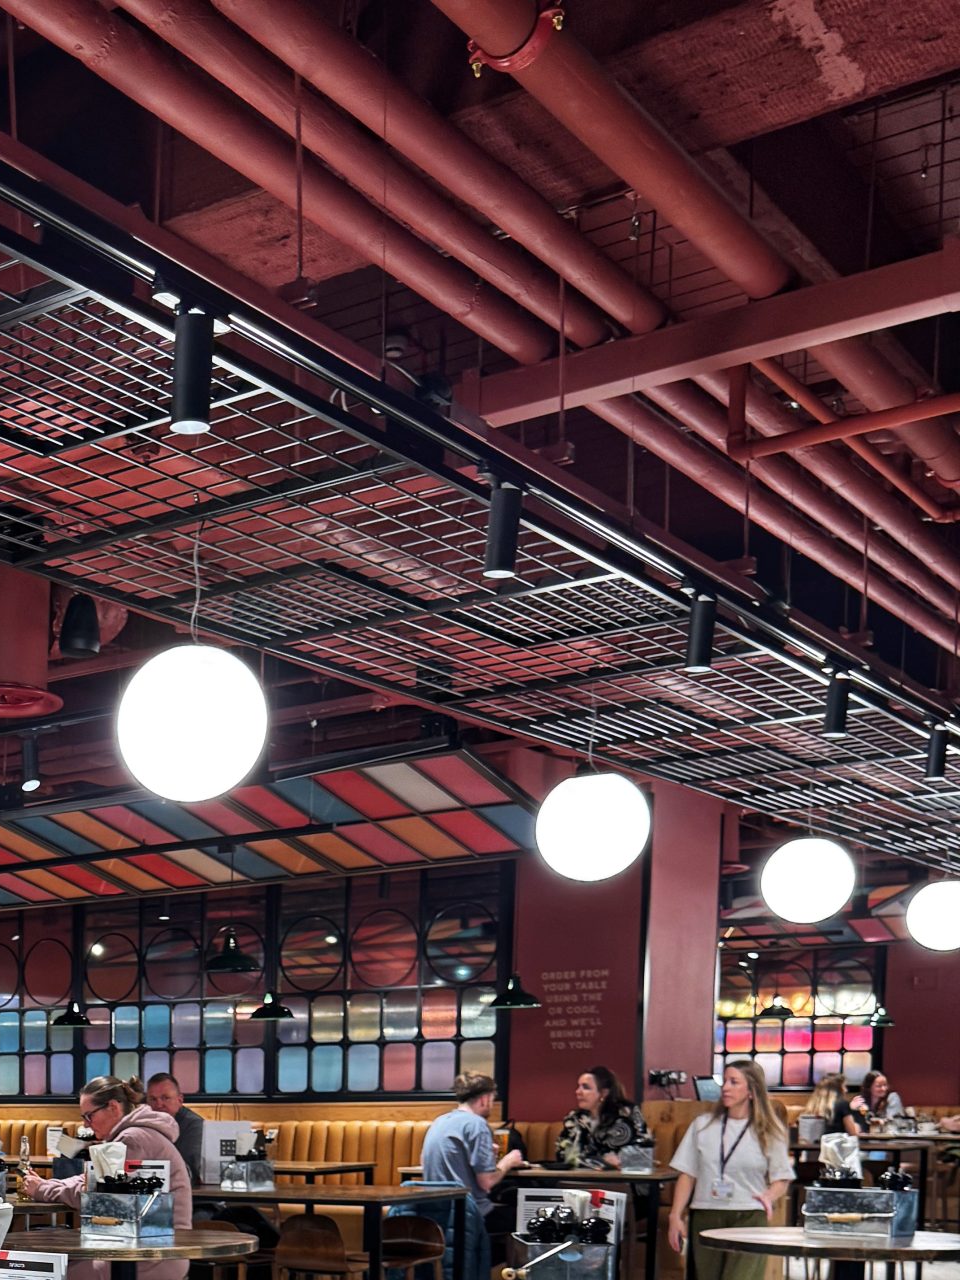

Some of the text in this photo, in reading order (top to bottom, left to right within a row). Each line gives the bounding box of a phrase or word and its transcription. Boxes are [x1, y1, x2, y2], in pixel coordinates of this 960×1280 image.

[541, 969, 609, 980] ORDER FROM
[543, 981, 607, 991] YOUR TABLE
[545, 993, 602, 1002] USING THE
[544, 1019, 567, 1027] AND
[550, 1029, 596, 1038] BRING IT
[551, 1041, 566, 1049] TO
